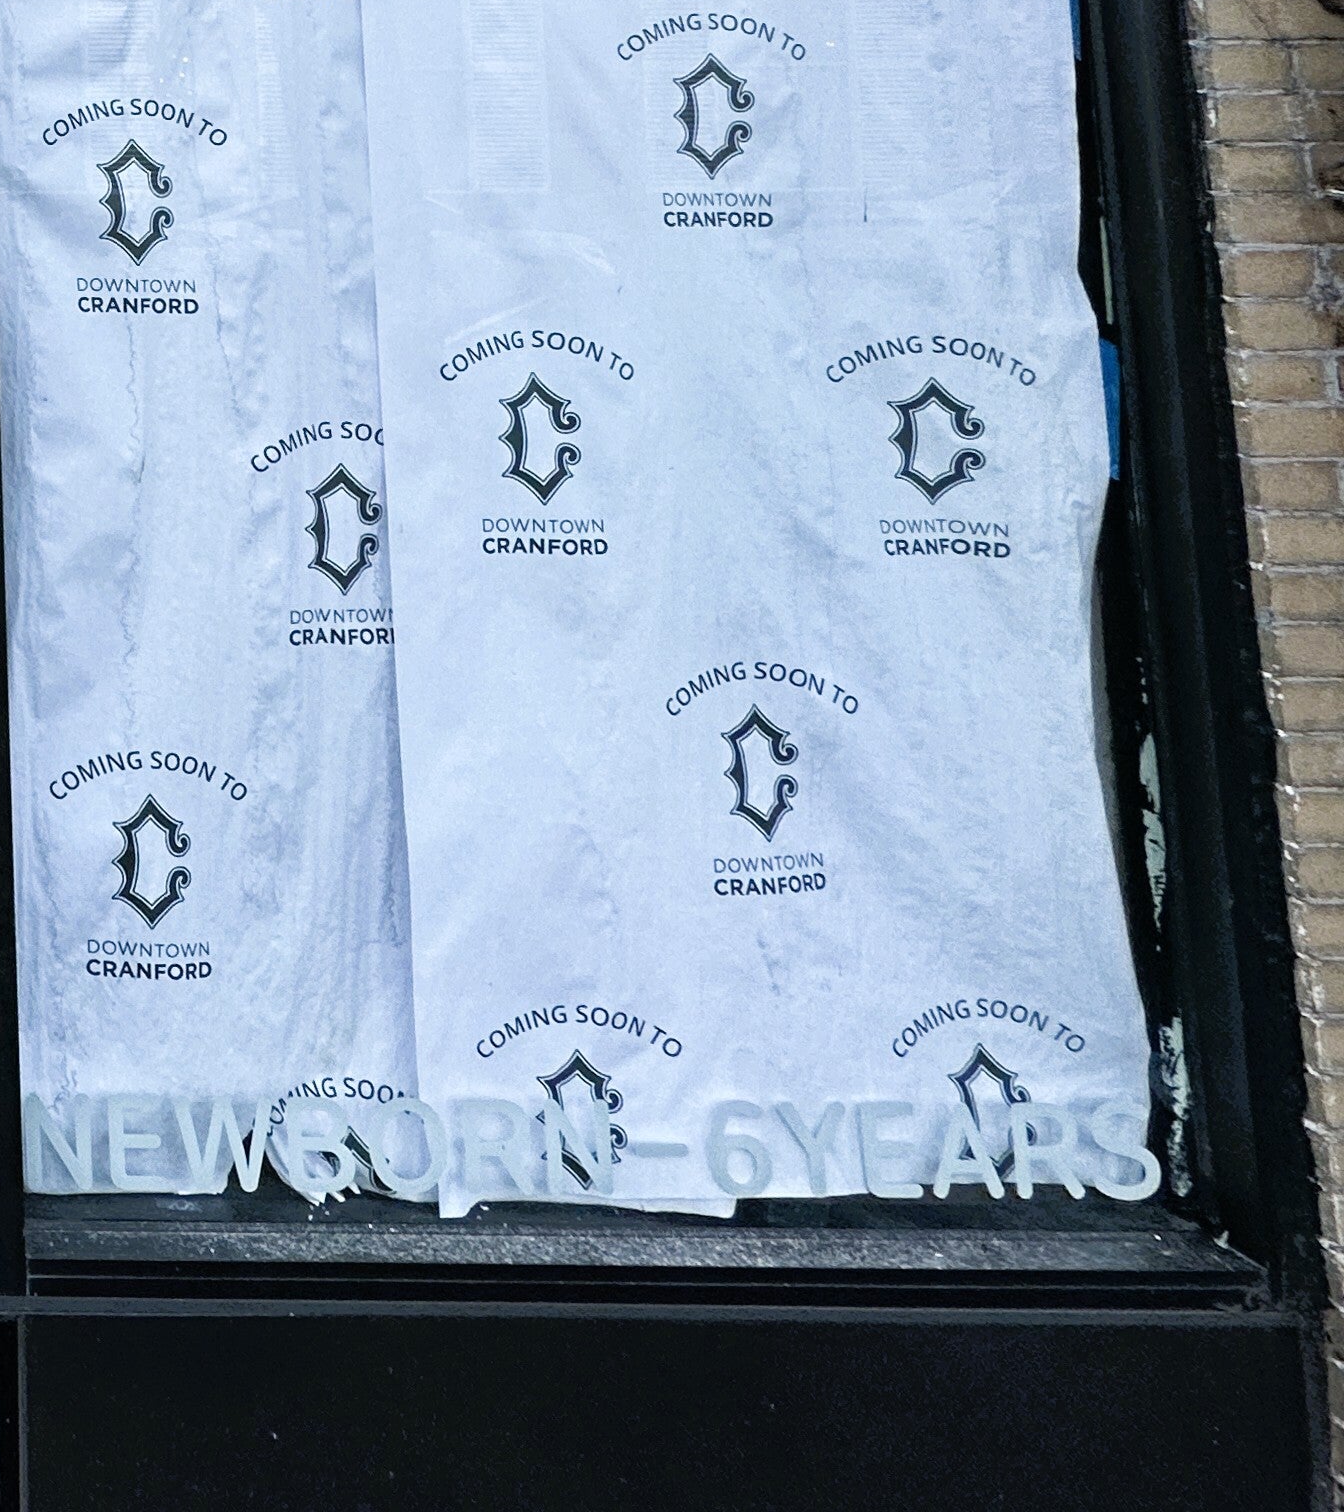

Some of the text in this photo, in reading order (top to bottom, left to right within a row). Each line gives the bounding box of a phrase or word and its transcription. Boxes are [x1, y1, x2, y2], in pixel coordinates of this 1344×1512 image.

[617, 13, 807, 61] COMING SOON TO
[42, 98, 227, 147] COMING SOON TO
[663, 193, 772, 207] DOWNTOWN
[663, 211, 773, 228] CRANFORD
[76, 277, 196, 293] DOWNTOWN
[77, 297, 199, 315] CRANFORD
[439, 329, 634, 383] COMING SOON TO
[825, 334, 1036, 387] COMING SOON TO
[251, 421, 333, 472] COMING
[482, 518, 604, 534] DOWNTOWN
[880, 518, 1009, 537] DOWNTOWN
[482, 537, 608, 556] CRANFORD
[884, 539, 1011, 559] CRANFORD
[665, 661, 859, 717] COMING SOON TO
[48, 750, 247, 801] COMING SOON TO
[713, 852, 824, 874] DOWNTOWN
[713, 872, 826, 897] CRANFORD
[87, 938, 209, 957] DOWNTOWN
[86, 959, 212, 981] CRANFORD
[476, 1005, 683, 1059] COMING SOON TO
[892, 998, 1085, 1059] COMING SOON TO
